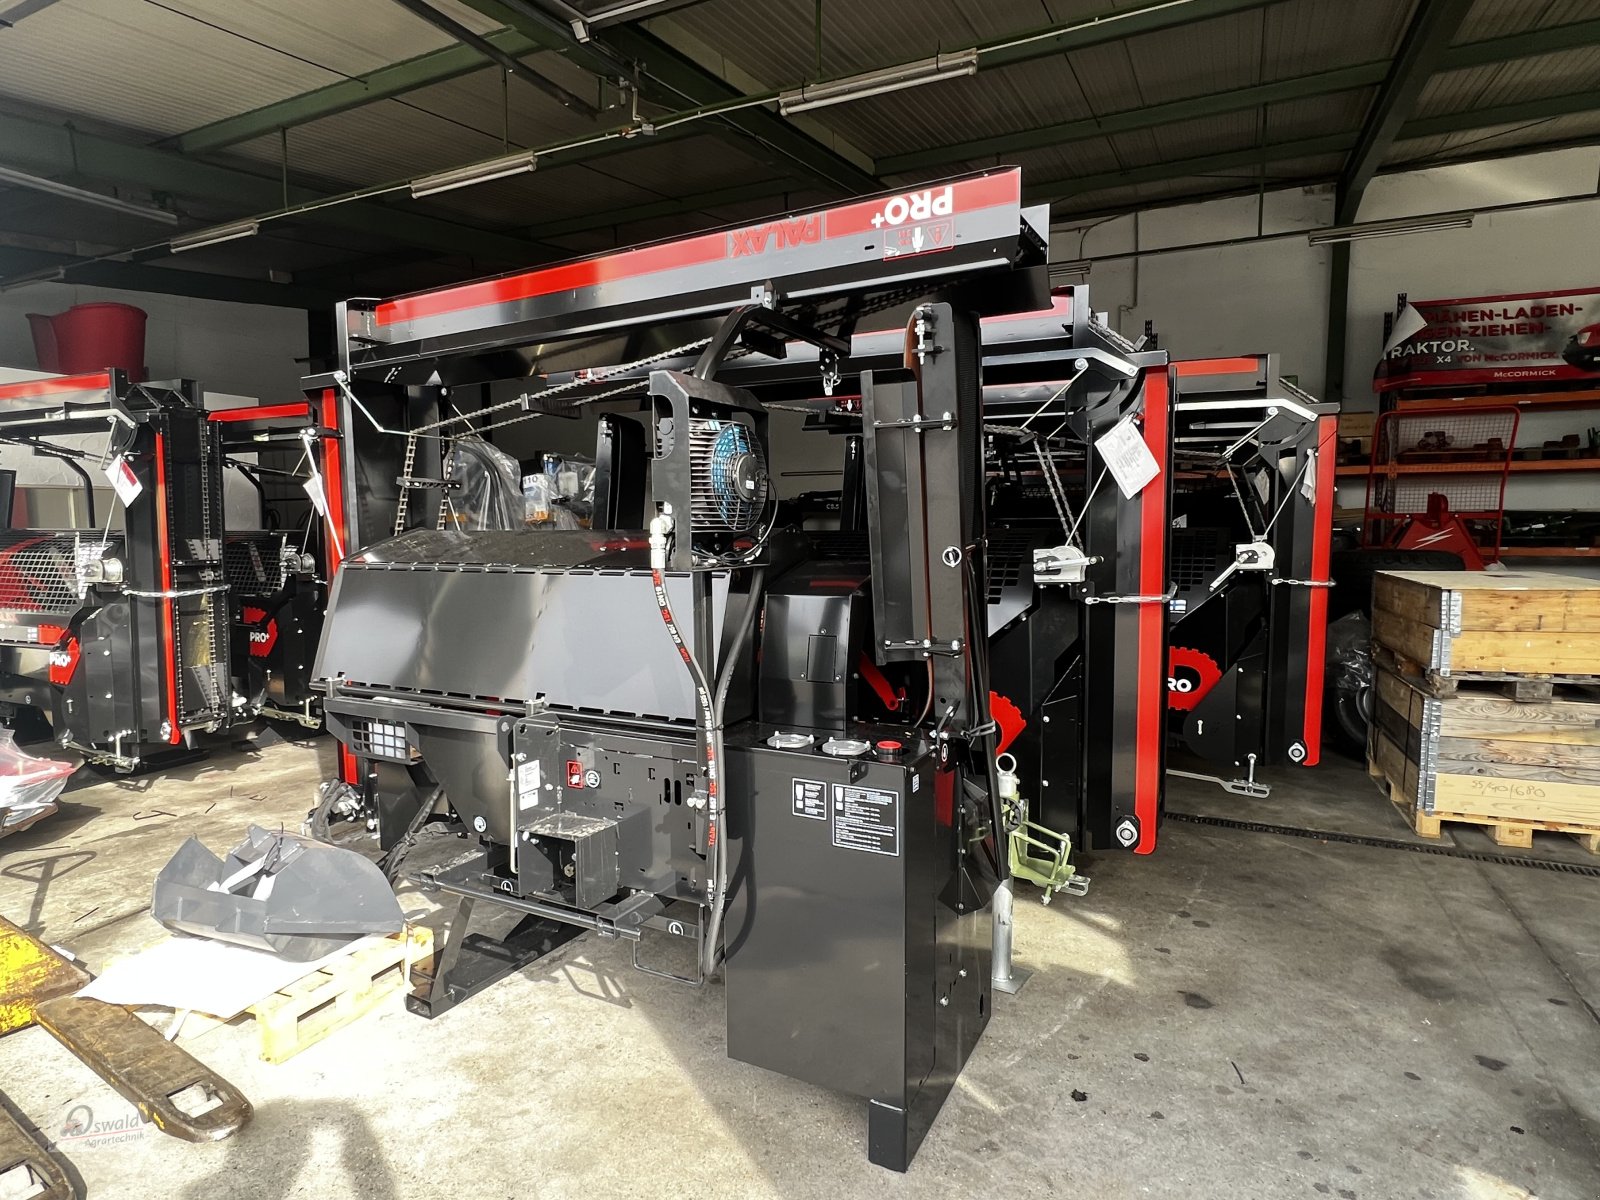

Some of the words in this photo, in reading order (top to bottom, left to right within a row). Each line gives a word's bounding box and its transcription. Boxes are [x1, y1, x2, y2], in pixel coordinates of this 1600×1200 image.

[871, 186, 953, 228] PRO+
[730, 211, 821, 259] PALAX
[1457, 354, 1481, 363] VON
[1494, 369, 1557, 378] McCORMICK
[250, 631, 270, 643] PRO+
[1168, 677, 1192, 693] RO
